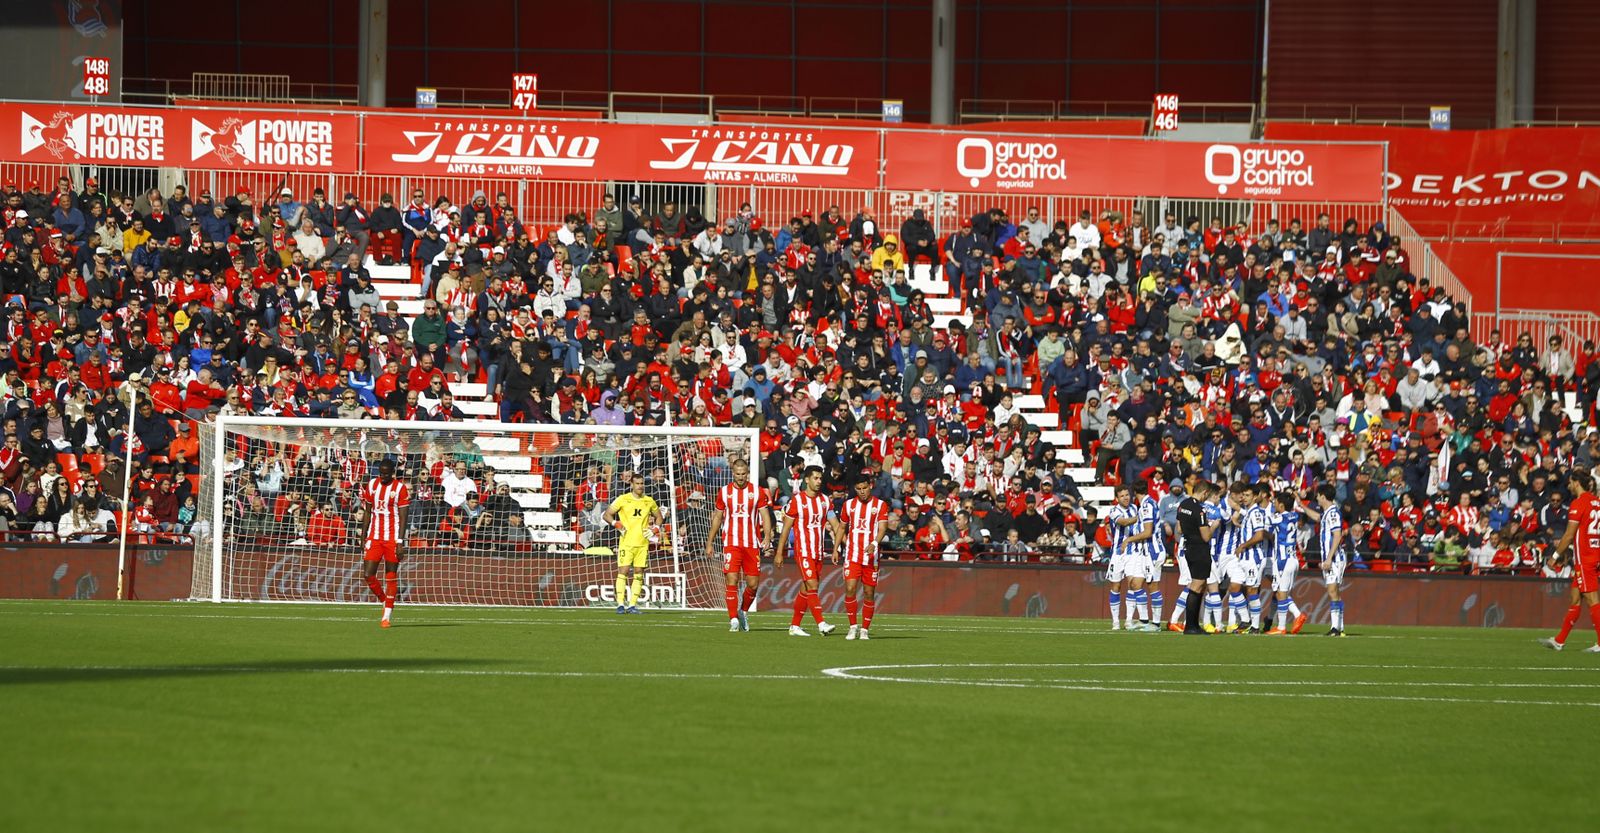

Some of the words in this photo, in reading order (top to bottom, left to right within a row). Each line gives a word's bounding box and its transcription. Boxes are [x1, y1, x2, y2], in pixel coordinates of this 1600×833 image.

[85, 59, 105, 75] 148
[85, 77, 105, 94] 48
[514, 75, 533, 91] 147
[514, 93, 533, 110] 47
[1156, 95, 1175, 111] 146
[884, 106, 900, 116] 146
[90, 113, 164, 138] POWER
[434, 122, 558, 134] TRANSPORTES
[1155, 113, 1174, 129] 46
[259, 119, 332, 143] POWER
[691, 129, 814, 142] TRANSPORTES
[90, 136, 164, 160] HORSE
[258, 142, 332, 167] HORSE
[995, 142, 1058, 163] grupo
[1243, 149, 1304, 170] grupo
[447, 164, 485, 174] ANTAS
[496, 165, 543, 175] ALMERIA
[704, 171, 741, 181] ANTAS
[752, 172, 798, 183] ALMERIA
[995, 159, 1067, 180] control
[1243, 165, 1314, 187] control
[996, 180, 1034, 189] seguridad
[1244, 187, 1281, 195] seguridad
[1388, 196, 1429, 208] igned
[1432, 198, 1450, 207] by
[1454, 192, 1564, 207] COSENTINO
[803, 558, 810, 569] 6
